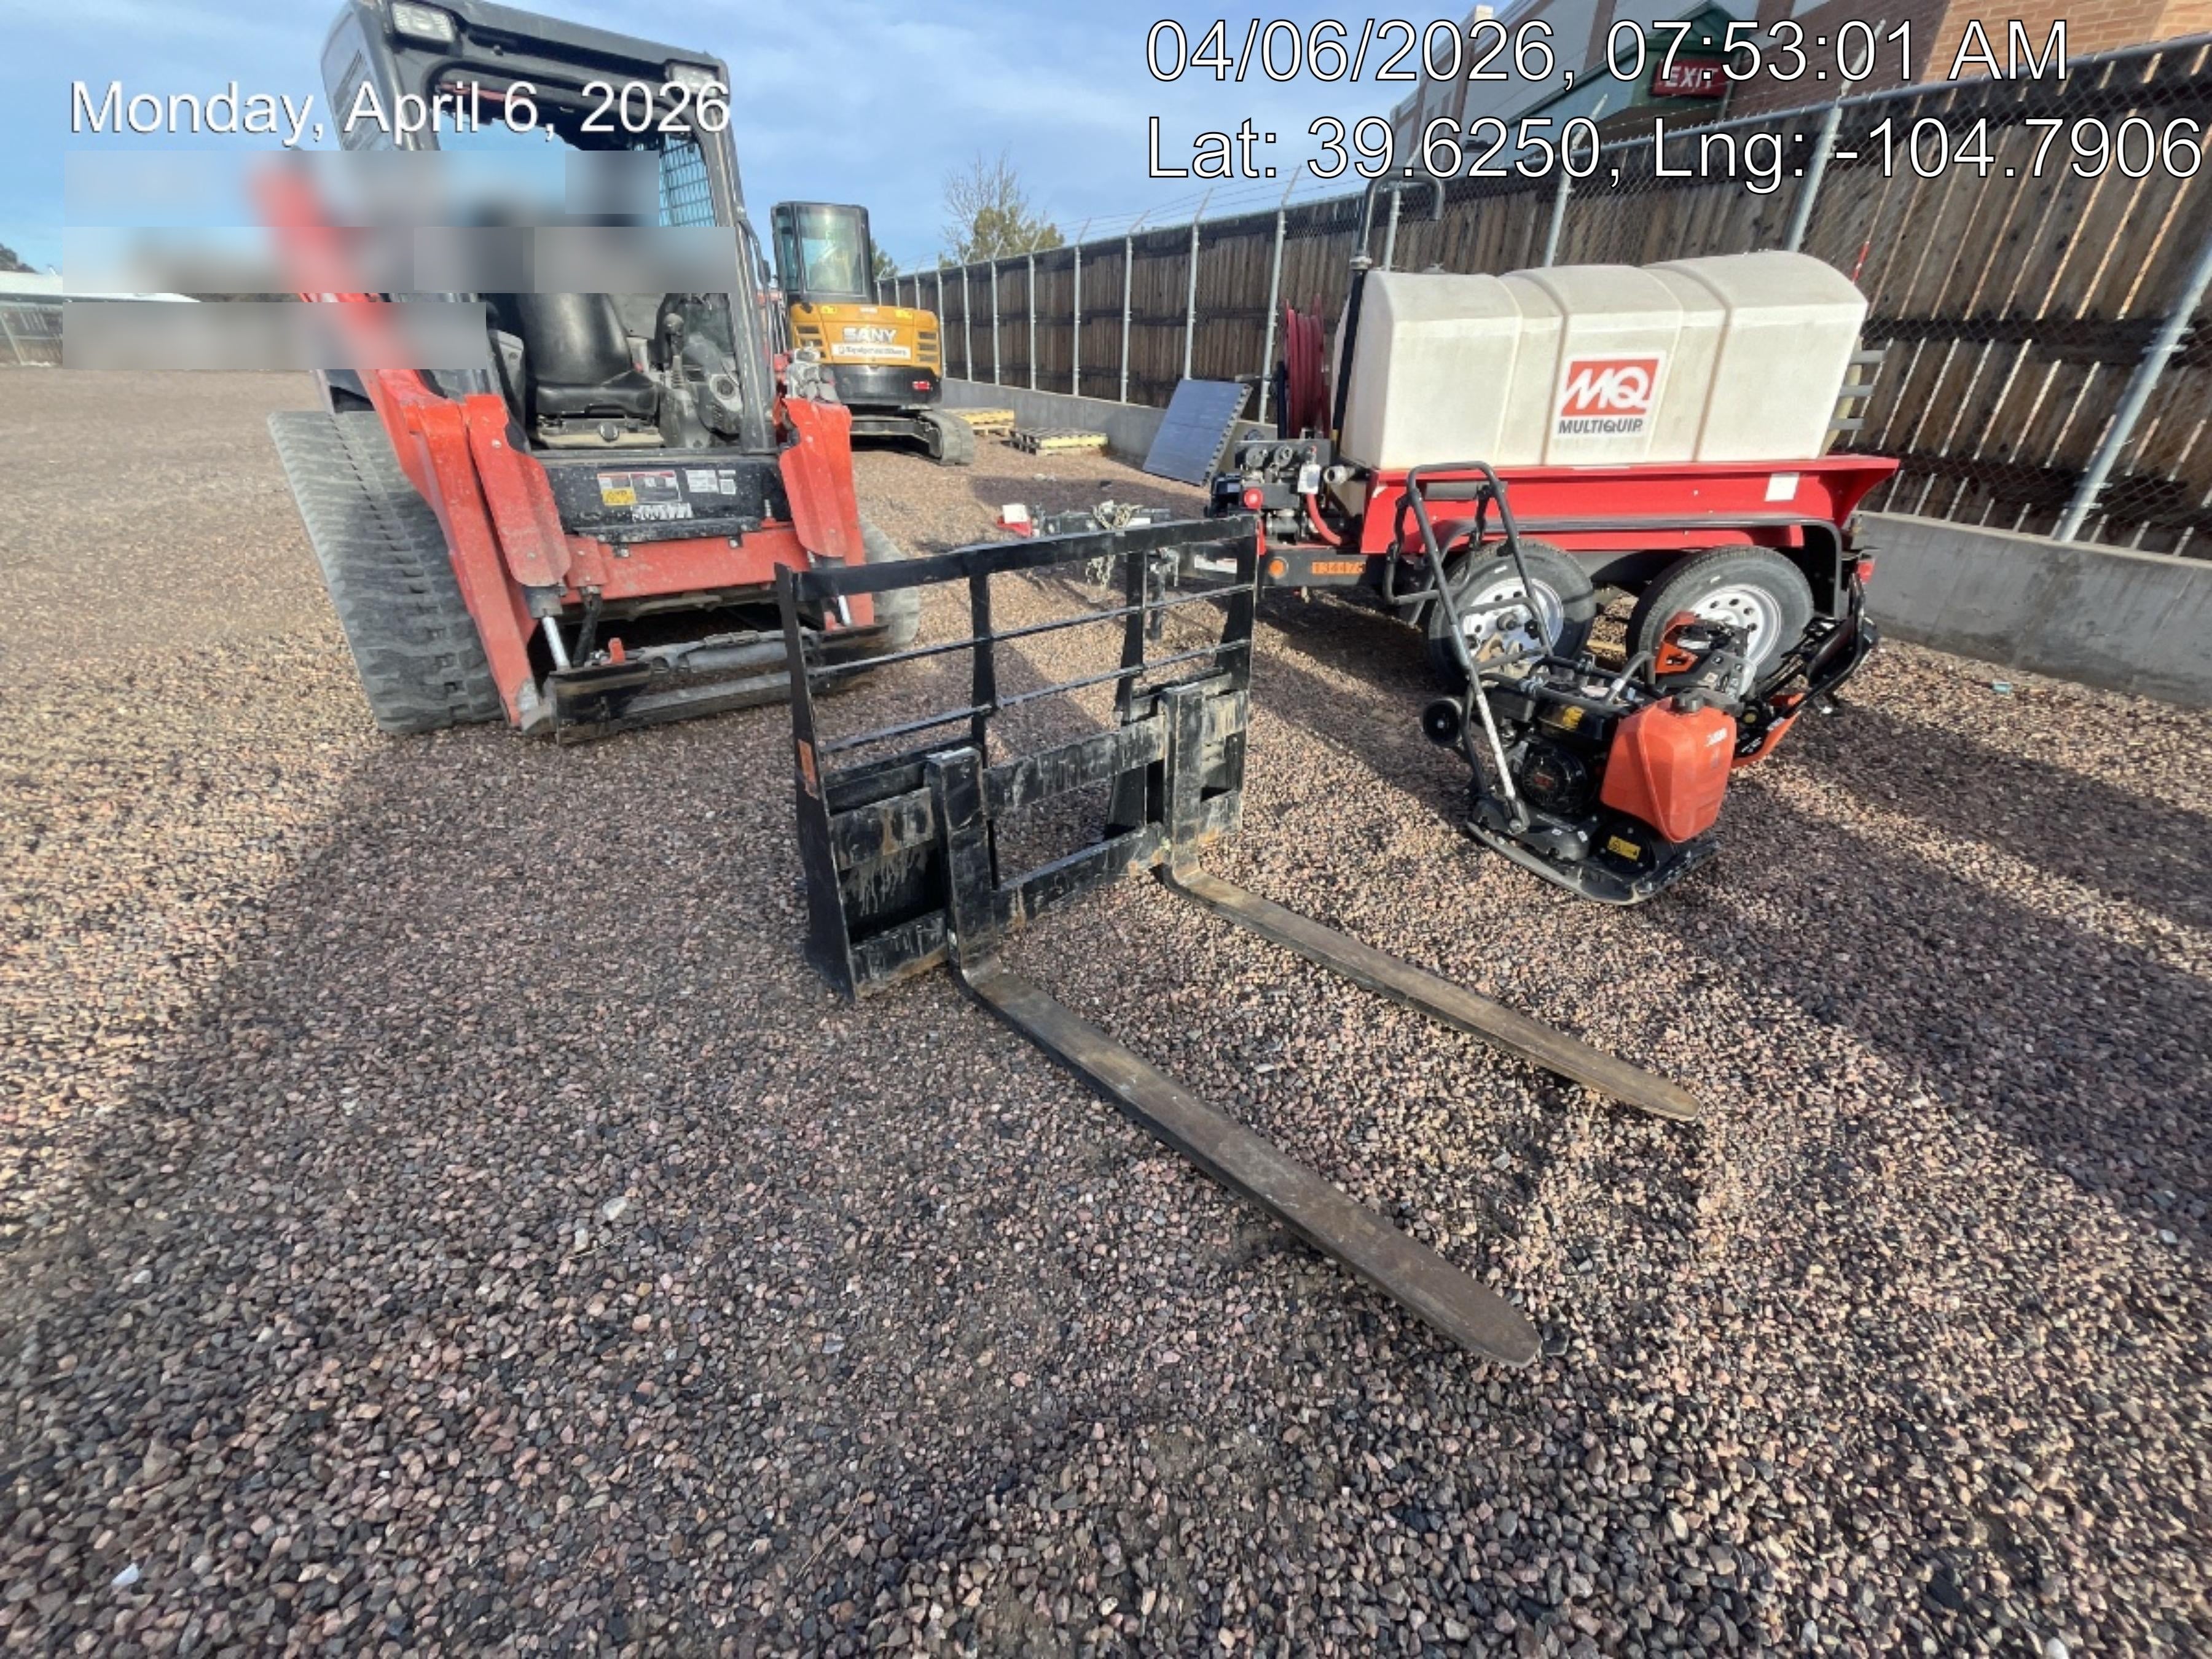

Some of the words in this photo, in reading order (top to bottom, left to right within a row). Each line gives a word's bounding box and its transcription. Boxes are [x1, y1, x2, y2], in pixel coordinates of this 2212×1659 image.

[1665, 66, 1719, 88] EXIT
[843, 327, 897, 343] SANY
[1563, 366, 1653, 410] MQ
[1558, 418, 1644, 434] MULTIQUIP
